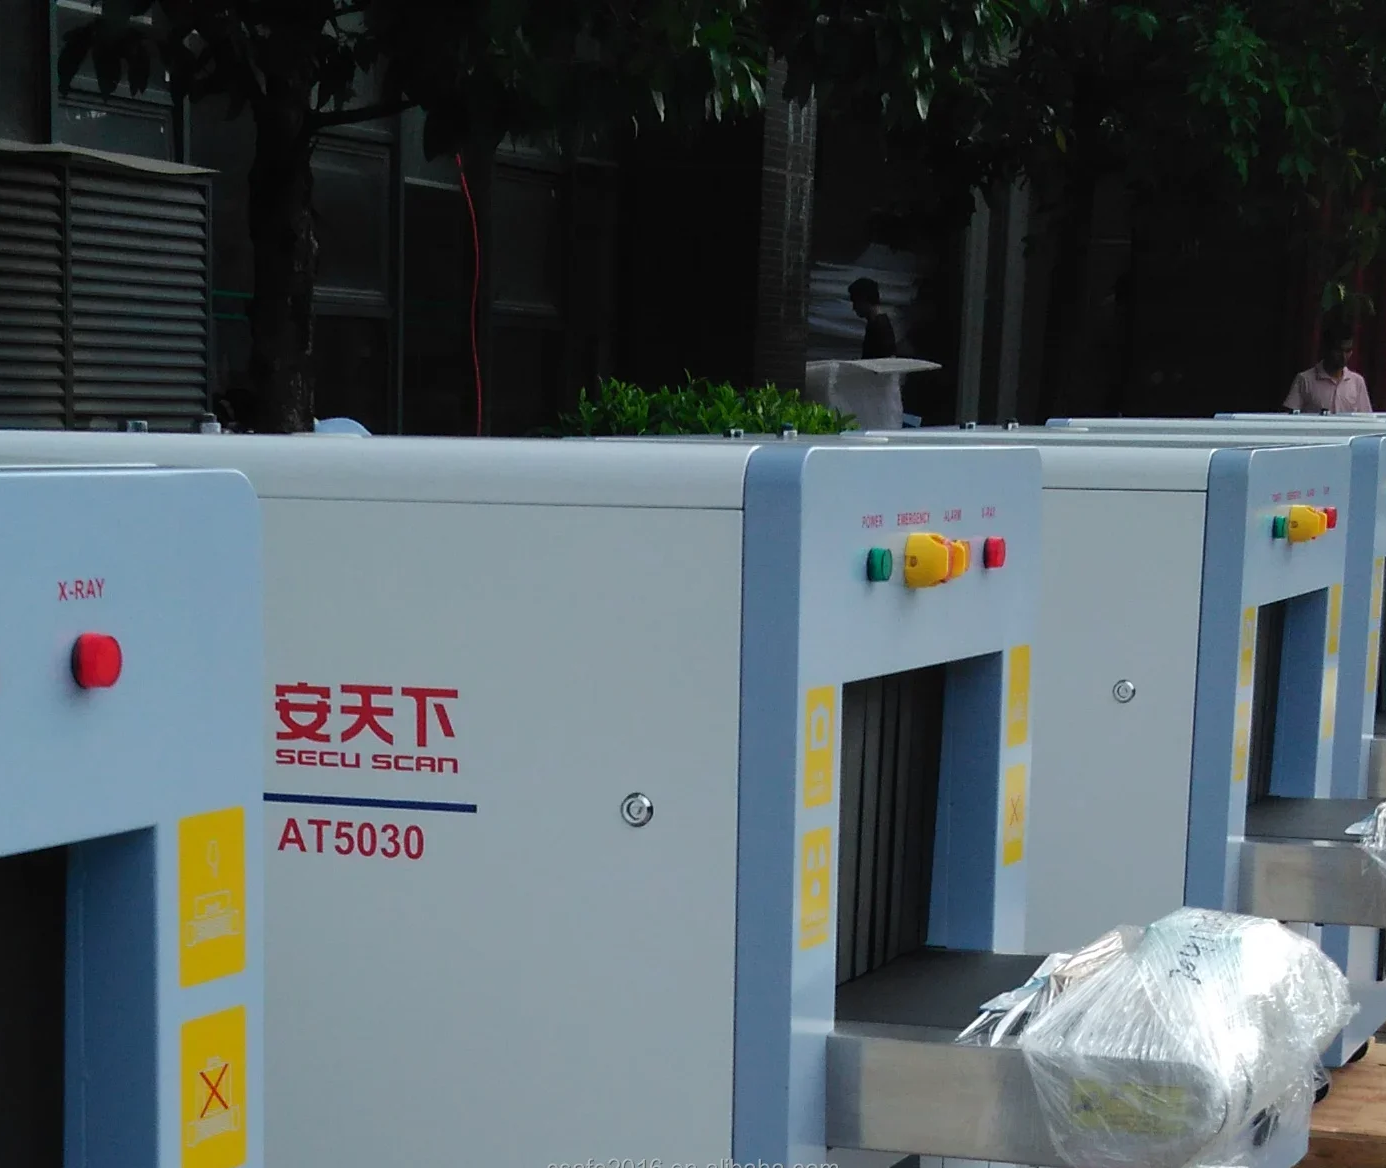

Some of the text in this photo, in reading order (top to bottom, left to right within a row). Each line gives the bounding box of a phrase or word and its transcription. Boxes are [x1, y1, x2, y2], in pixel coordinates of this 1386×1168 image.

[57, 578, 105, 602] X-RAY
[275, 682, 459, 748] 安天下
[275, 748, 459, 774] SECU SCAN
[277, 817, 424, 860] AT5030
